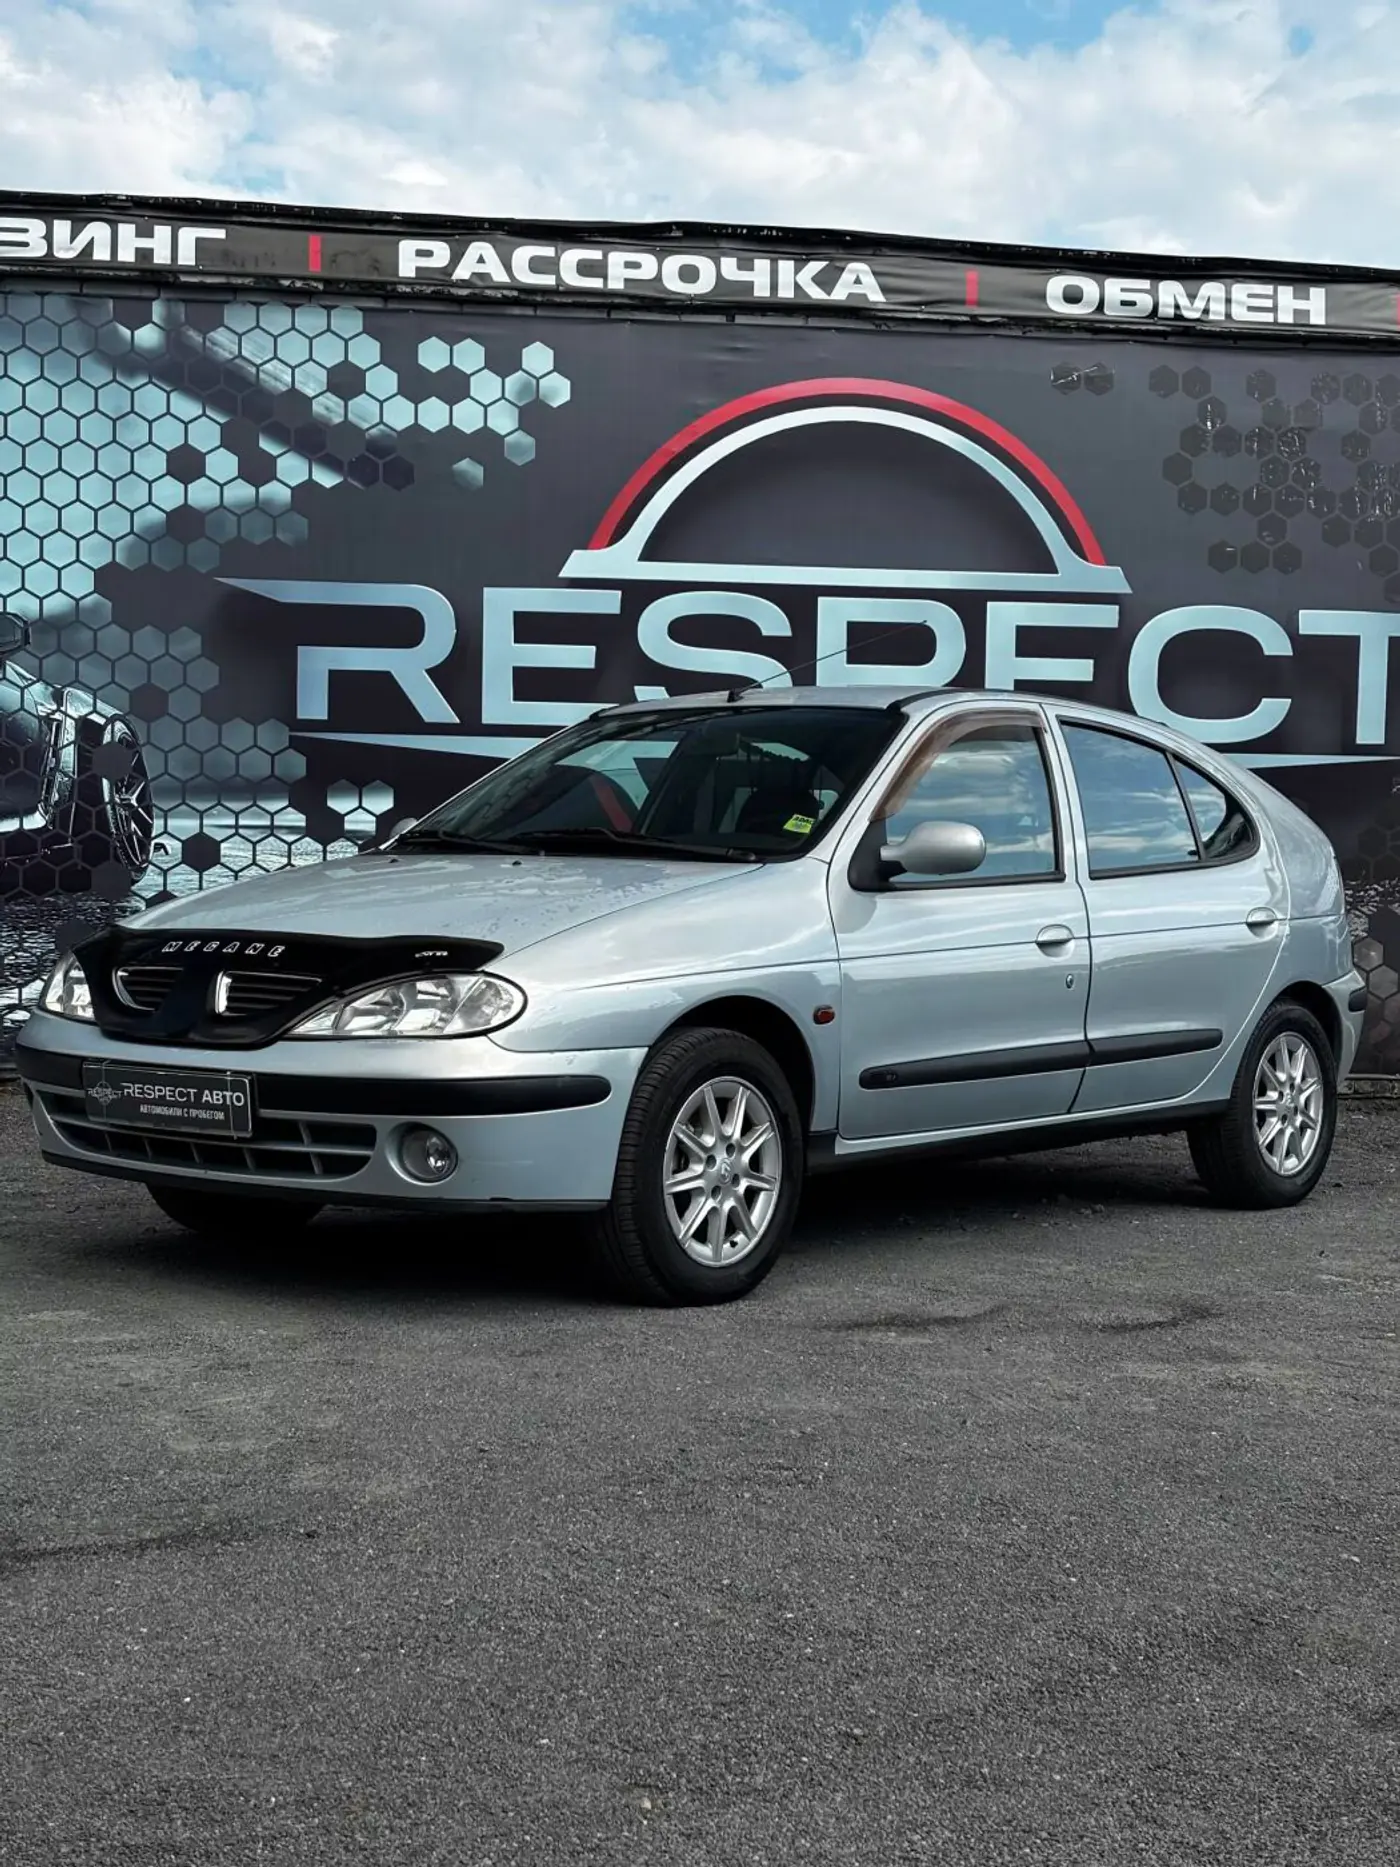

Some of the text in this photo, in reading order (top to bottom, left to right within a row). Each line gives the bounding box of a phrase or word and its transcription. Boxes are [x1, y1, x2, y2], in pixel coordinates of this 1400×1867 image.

[397, 239, 887, 303] РАССРОЧКА
[1045, 274, 1327, 326] ОБМЕН
[214, 577, 1400, 745] RESPECT
[161, 940, 286, 958] MEGANE
[120, 1083, 245, 1107] RESPECT АВТО
[140, 1104, 225, 1120] АВТОМОБИЛИ С ПРОБЕГОМ
